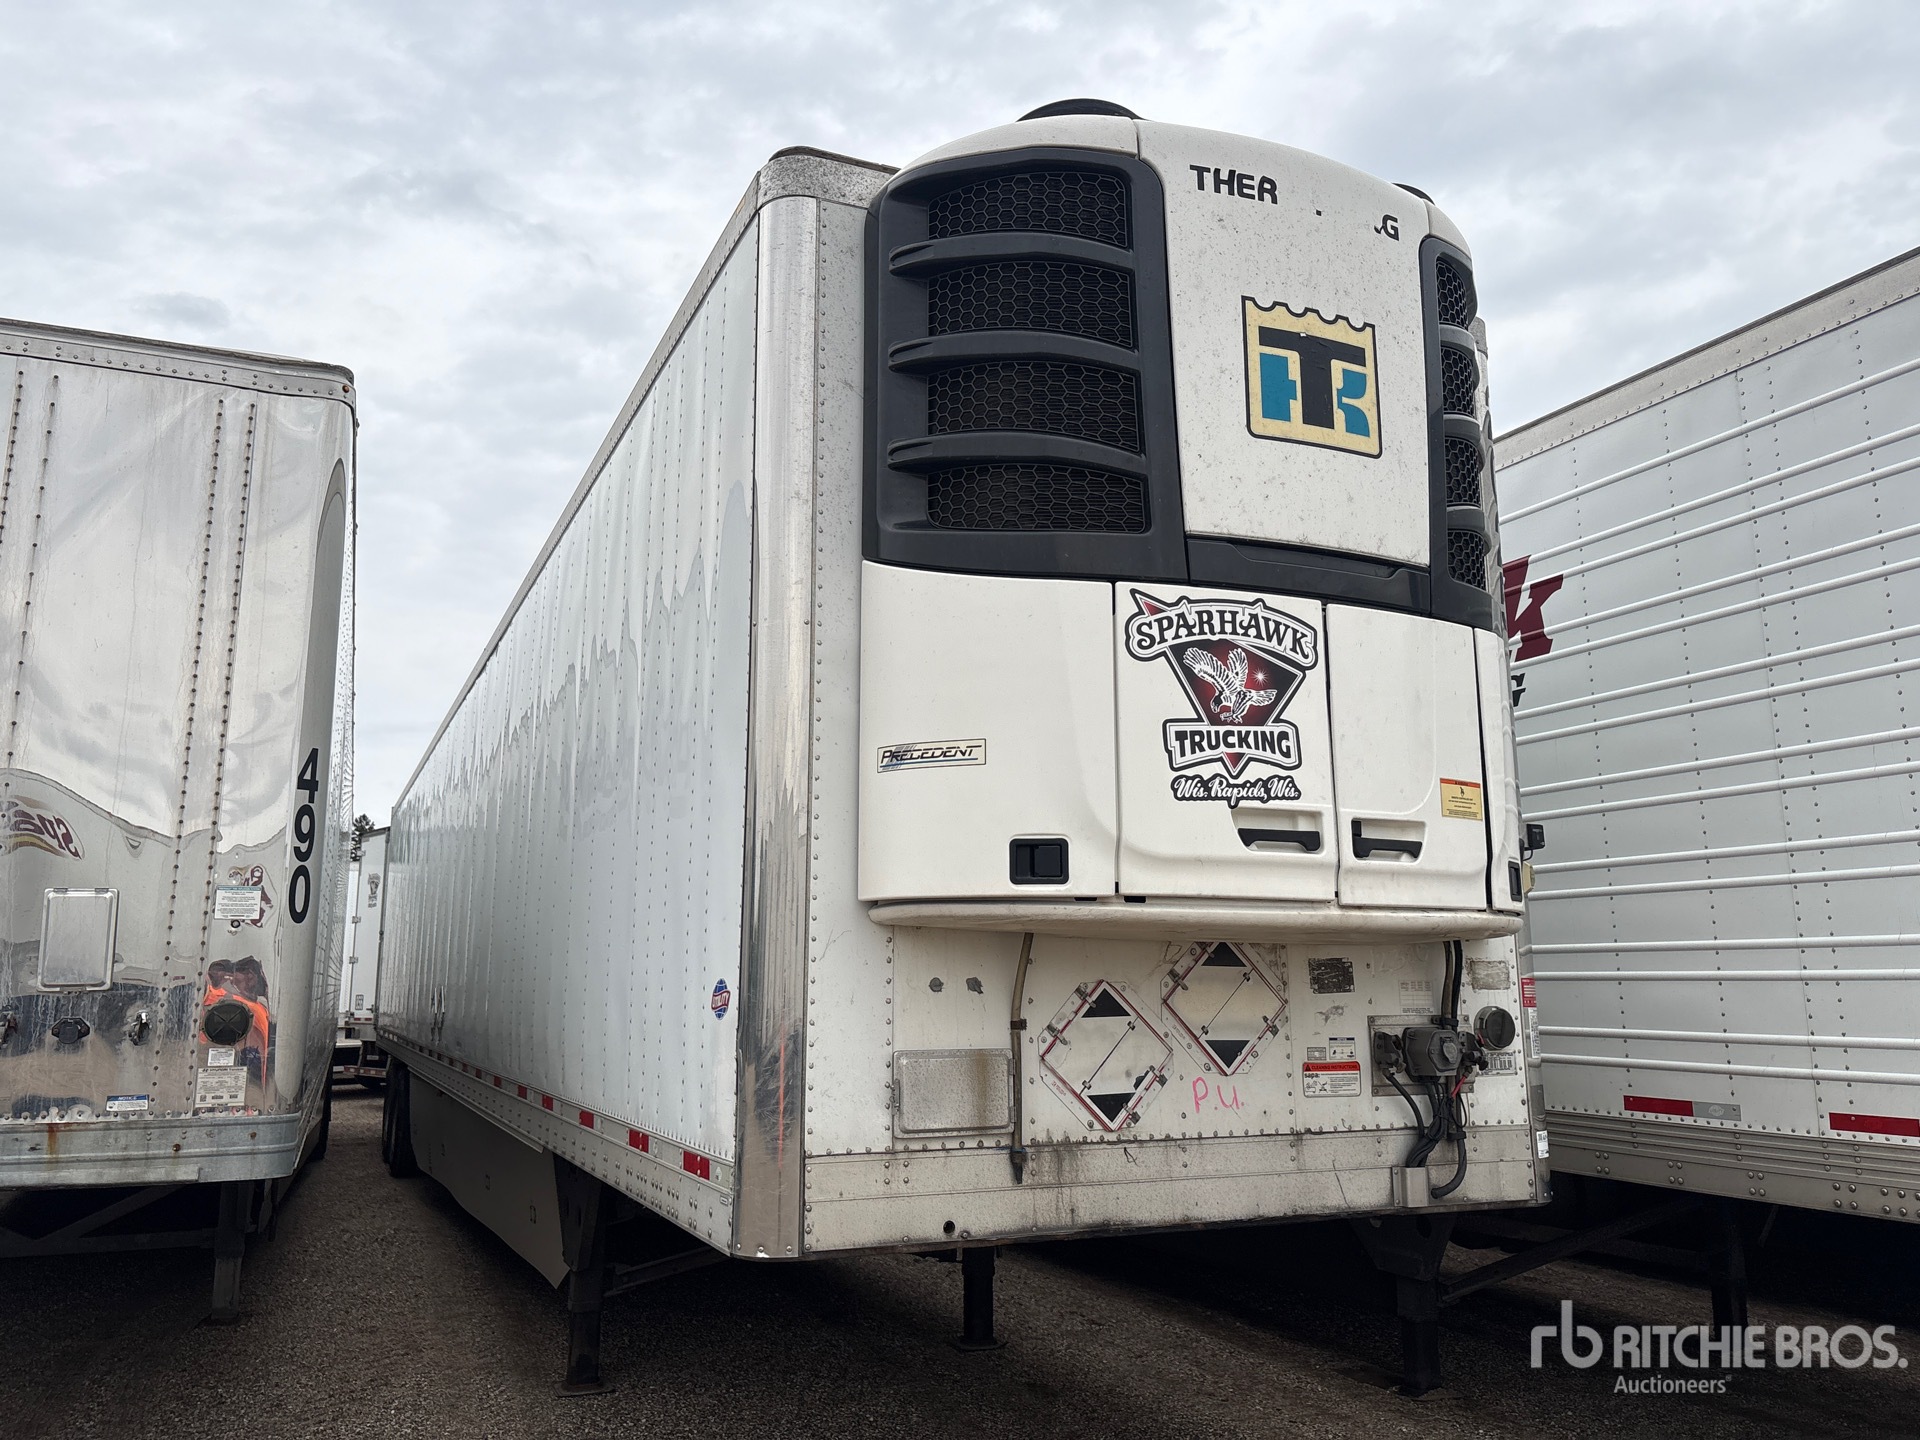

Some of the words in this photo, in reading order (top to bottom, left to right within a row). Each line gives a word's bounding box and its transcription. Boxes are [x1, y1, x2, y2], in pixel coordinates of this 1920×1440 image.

[1136, 609, 1312, 660] SPARHAWK
[880, 744, 983, 765] PRECEDENT
[1174, 729, 1293, 759] TRUCKING
[1174, 777, 1209, 798] Wis.
[1208, 776, 1268, 806] Rapids,
[1267, 777, 1300, 798] Wis.
[288, 747, 319, 924] 490
